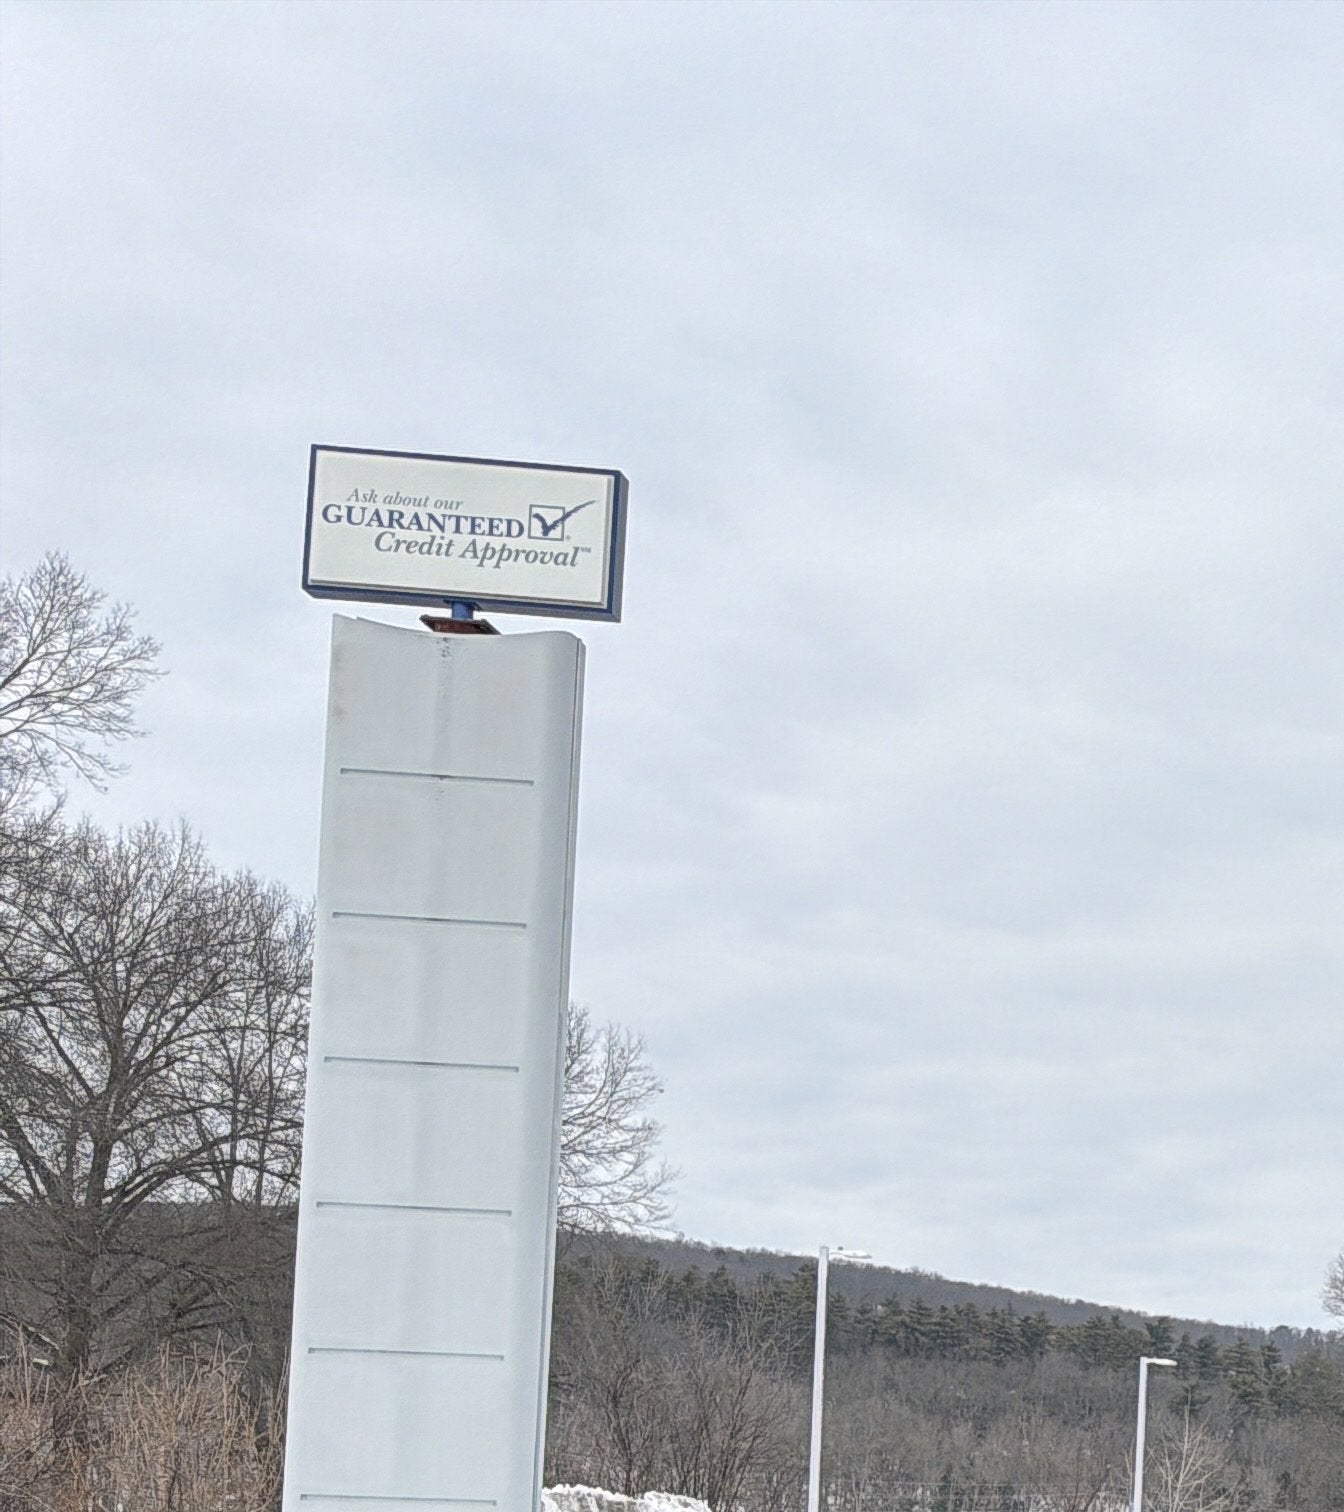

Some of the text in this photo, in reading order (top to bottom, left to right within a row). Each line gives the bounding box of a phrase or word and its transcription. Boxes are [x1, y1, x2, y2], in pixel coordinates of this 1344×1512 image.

[347, 487, 464, 511] Ask about our
[321, 503, 525, 538] GUARANTEED
[374, 530, 580, 569] Credit Approval
